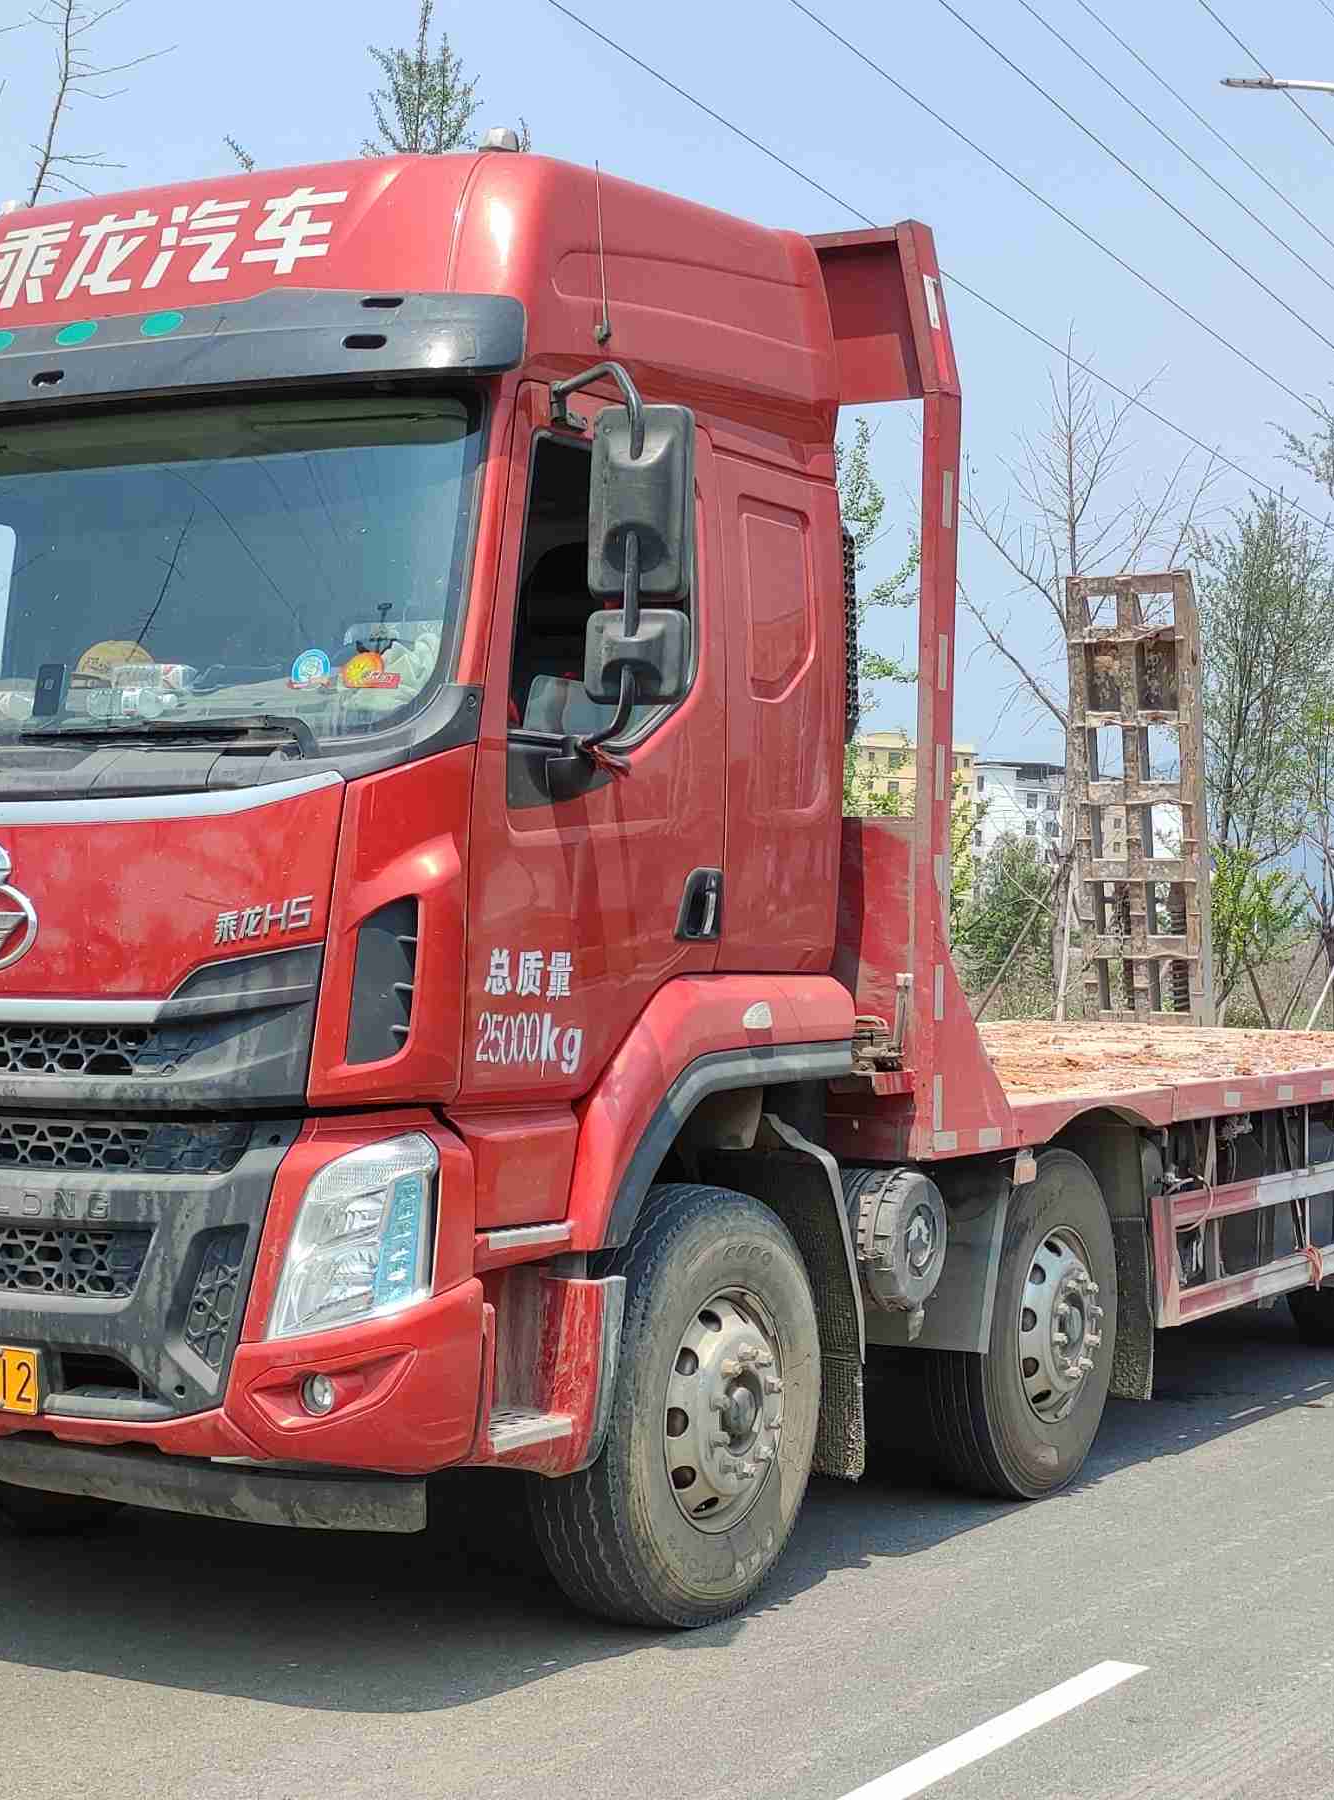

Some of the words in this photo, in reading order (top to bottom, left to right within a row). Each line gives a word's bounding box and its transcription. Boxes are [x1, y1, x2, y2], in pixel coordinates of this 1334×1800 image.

[484, 947, 574, 998] 总质量
[475, 1011, 583, 1074] 25000kg
